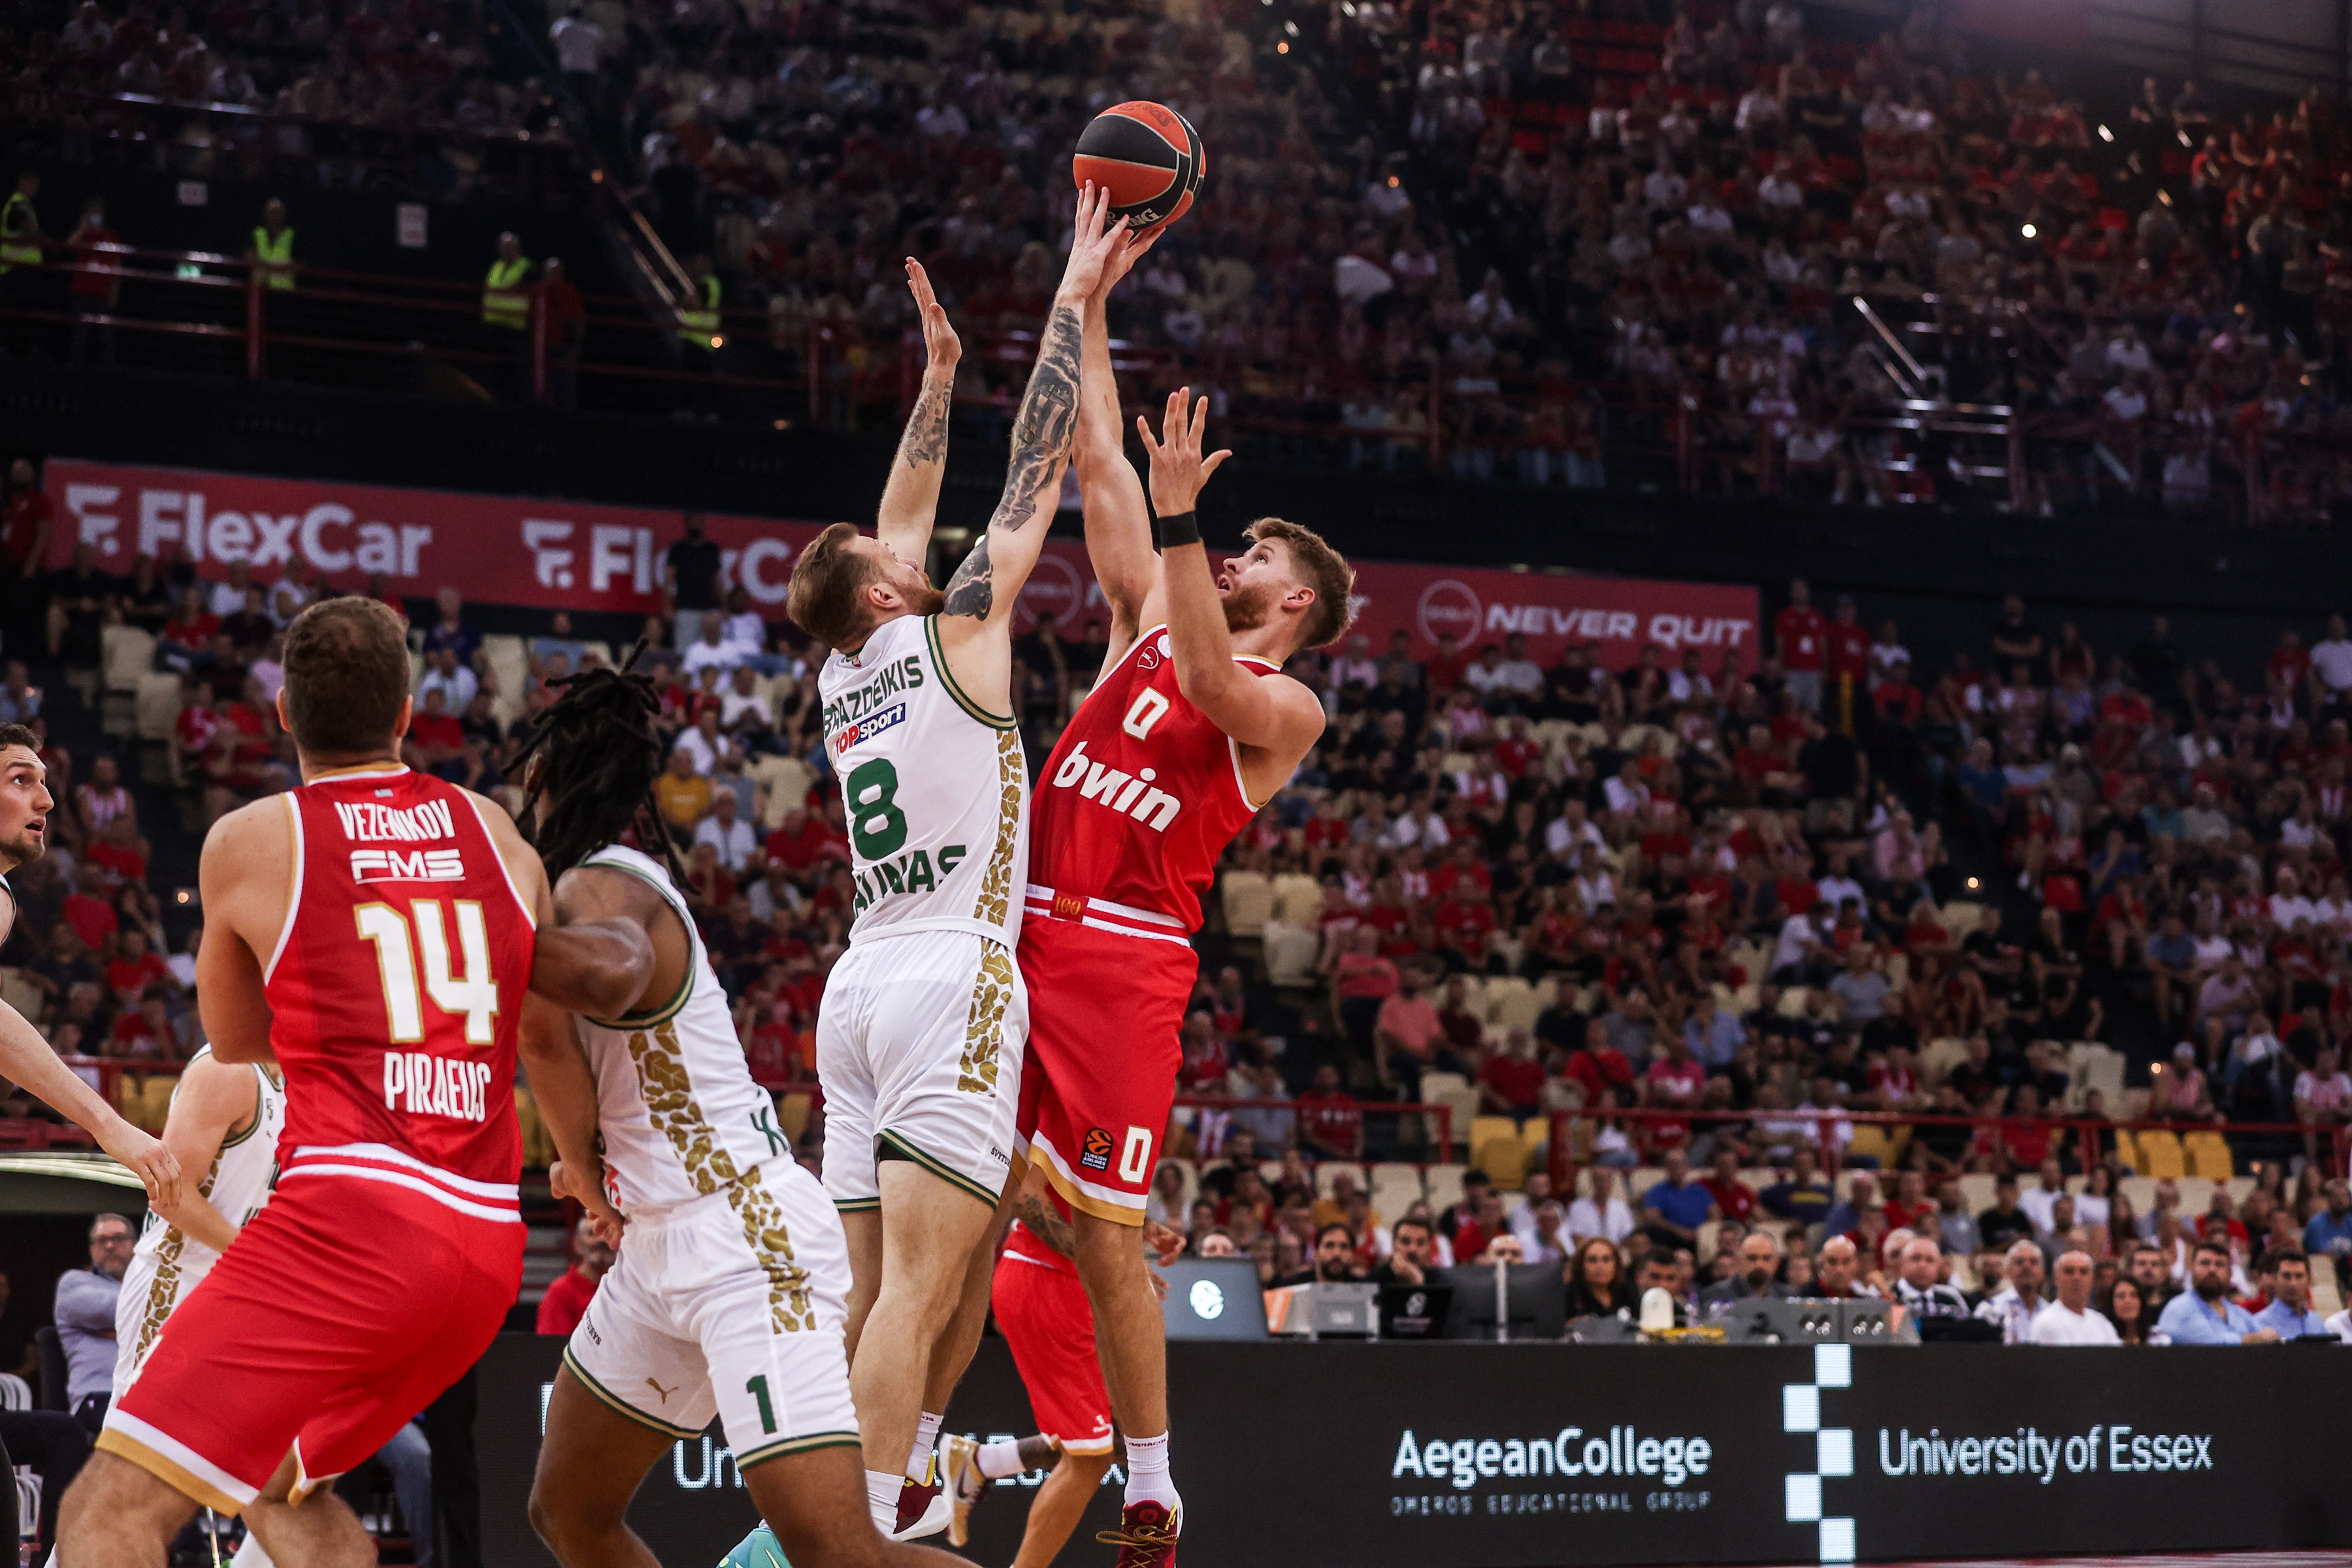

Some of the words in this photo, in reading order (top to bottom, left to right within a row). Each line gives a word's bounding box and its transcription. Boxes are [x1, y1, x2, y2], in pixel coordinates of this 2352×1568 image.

[139, 489, 433, 577] FlexCar
[1486, 602, 1638, 640] NEVER
[1648, 613, 1752, 649] QUIT
[823, 655, 924, 740] BRAZDEIKIS
[1122, 686, 1170, 742] 0
[847, 757, 908, 861] 8
[1052, 740, 1181, 832] bwin
[335, 798, 455, 841] VEZENKOV
[350, 849, 465, 881] FMS
[353, 898, 500, 1045] 14
[383, 1051, 491, 1123] PIRAEUS
[1118, 1124, 1153, 1184] 0
[746, 1374, 777, 1436] 1
[1392, 1424, 1712, 1490] AegeanCollege
[1879, 1426, 2061, 1485] University
[2065, 1424, 2103, 1473] of
[2108, 1424, 2214, 1473] Essex
